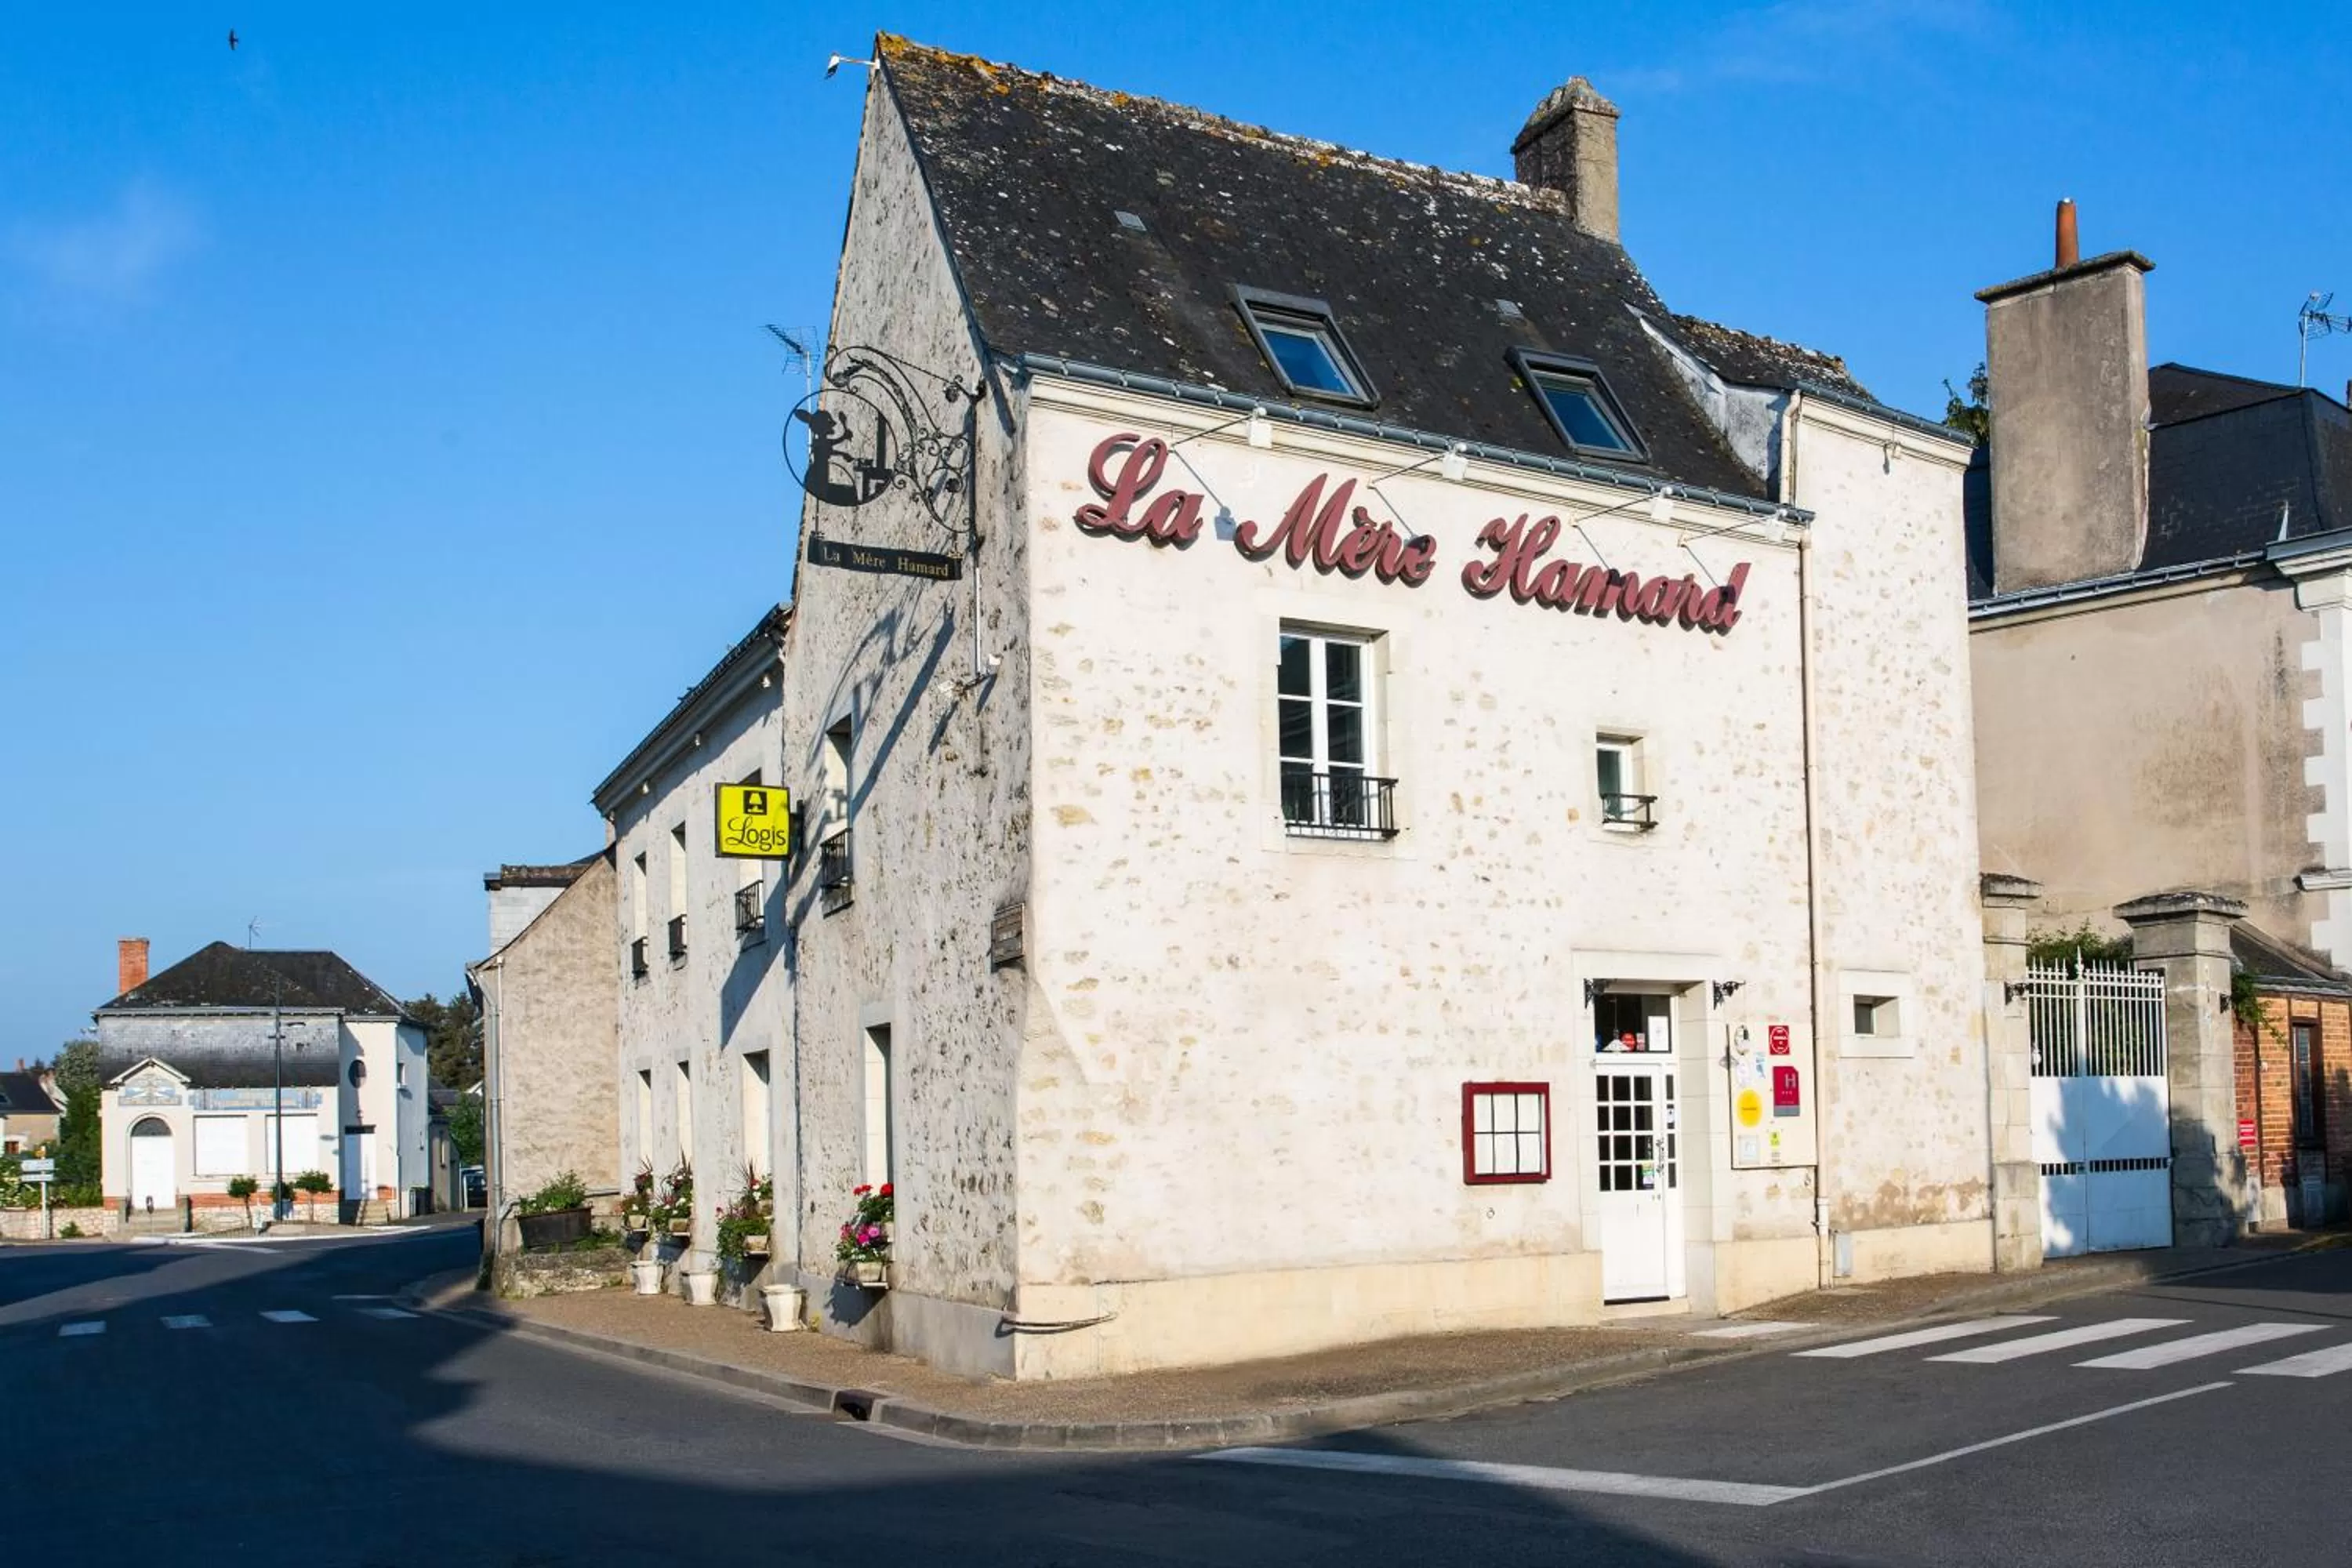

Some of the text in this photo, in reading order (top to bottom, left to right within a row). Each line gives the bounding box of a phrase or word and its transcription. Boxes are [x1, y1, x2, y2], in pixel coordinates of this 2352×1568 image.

[1076, 432, 1751, 630] La Mère Hamard
[822, 546, 949, 577] La Mère Hamard
[725, 815, 786, 852] Logis
[1784, 1073, 1797, 1089] H
